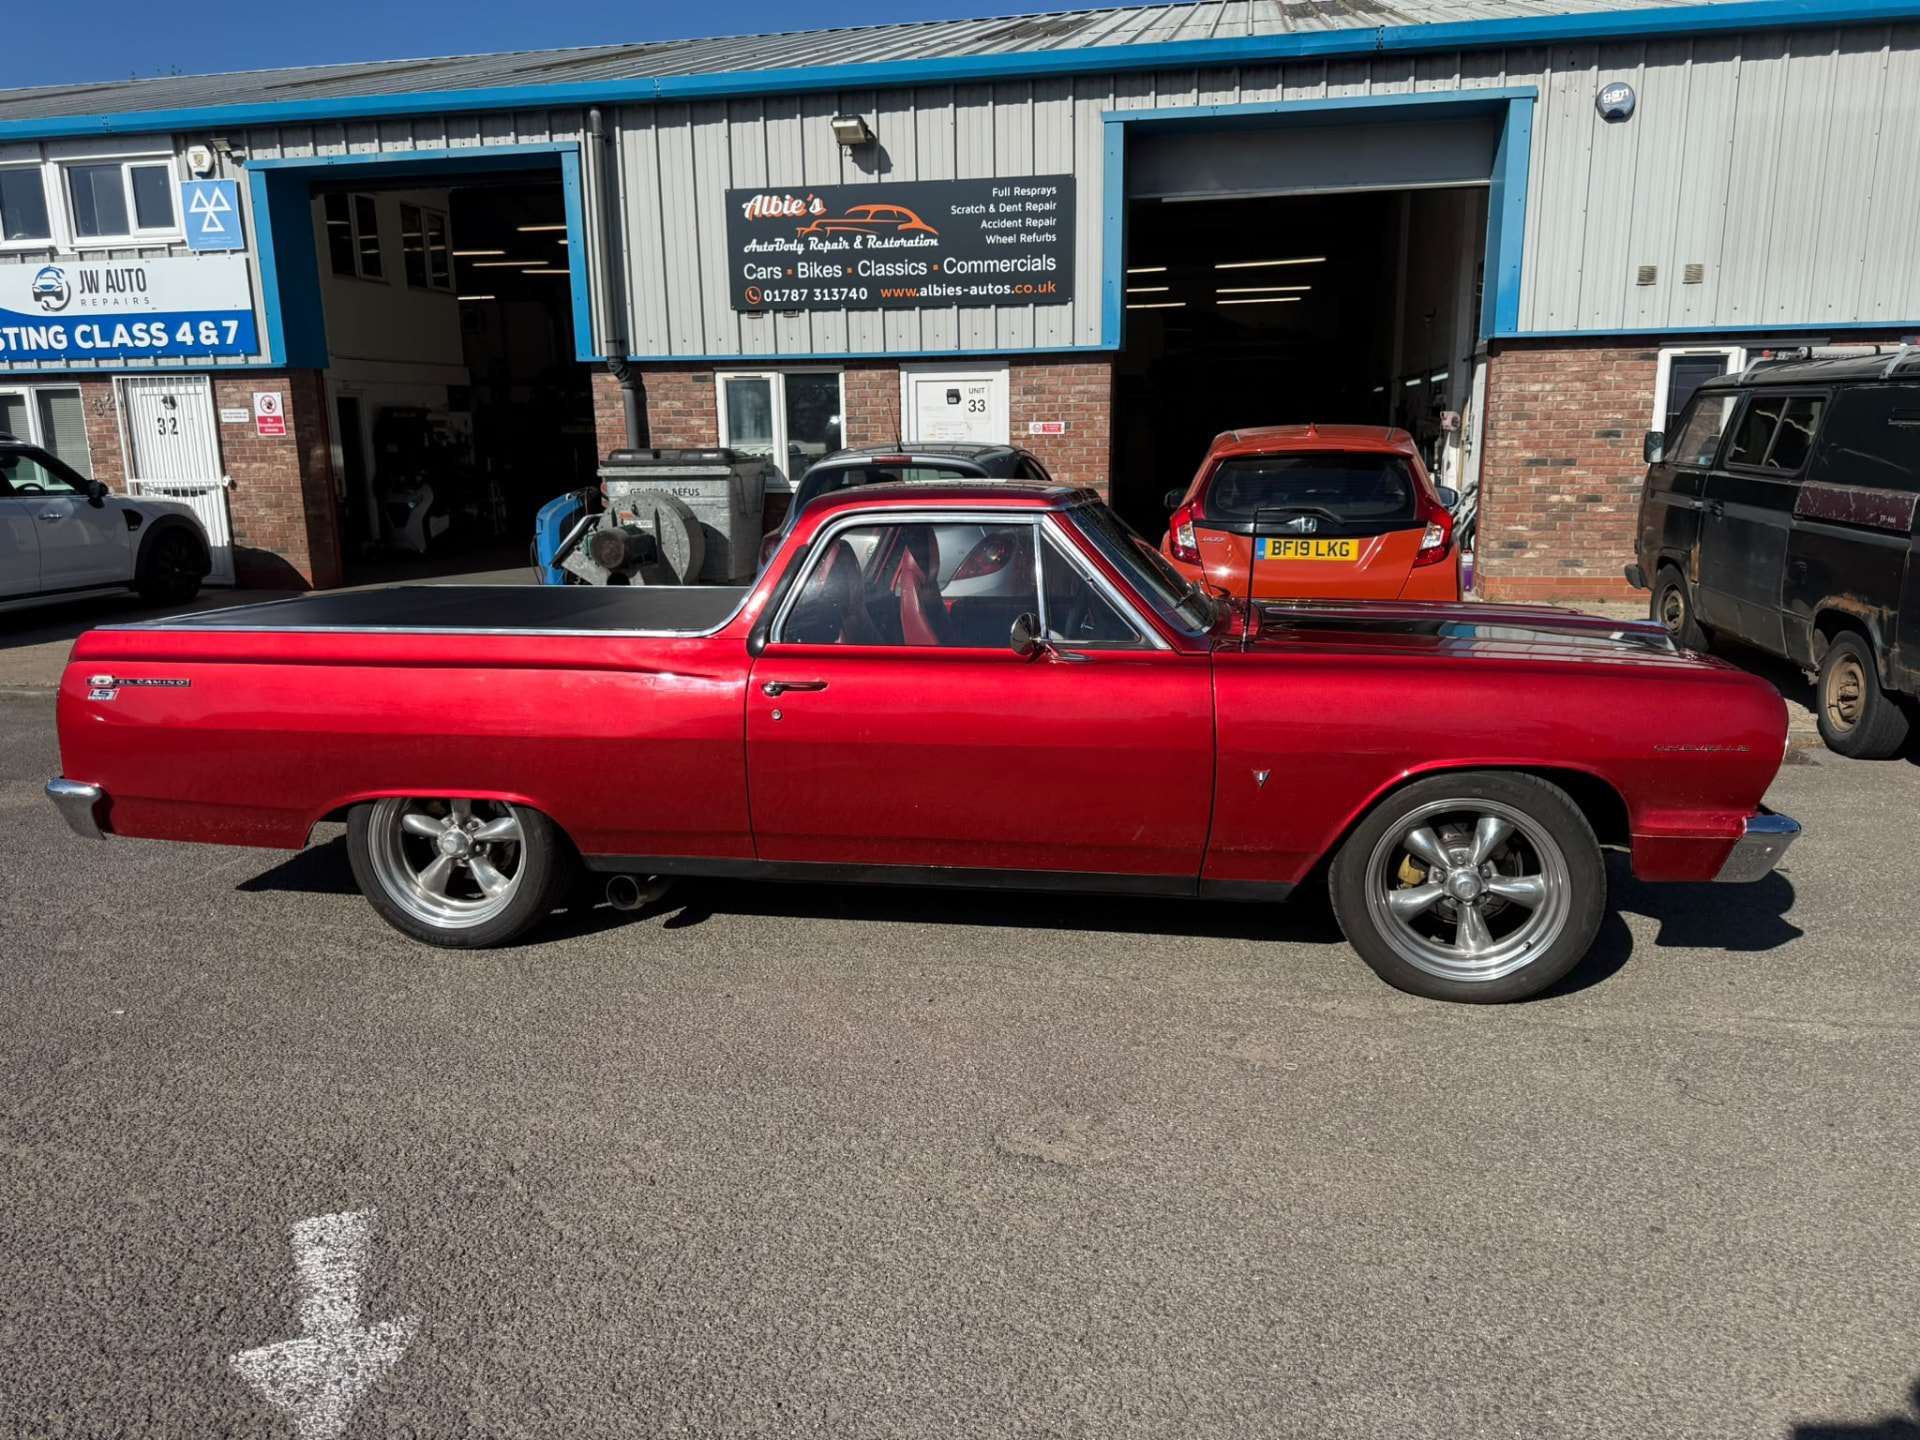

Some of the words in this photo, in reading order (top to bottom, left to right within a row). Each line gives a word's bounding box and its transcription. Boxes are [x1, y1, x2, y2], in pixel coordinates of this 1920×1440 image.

[992, 187, 1010, 197] Full
[1014, 186, 1057, 197] Resprays
[742, 193, 826, 220] Albie's
[951, 204, 985, 215] Scratch
[988, 203, 996, 213] &
[999, 202, 1022, 213] Dent
[1025, 201, 1057, 213] Repair
[980, 218, 1022, 229] Accident
[1025, 216, 1057, 228] Repair
[743, 238, 805, 255] AutoBody
[808, 236, 850, 253] Repair
[853, 235, 863, 249] &
[866, 233, 939, 249] Restoration
[985, 234, 1016, 244] Wheel
[1020, 232, 1057, 243] Refurbs
[743, 263, 782, 280] Cars
[797, 261, 842, 278] Bikes
[857, 259, 927, 277] Classics
[943, 254, 1056, 274] Commercials
[79, 269, 100, 294] JW
[106, 267, 147, 293] AUTO
[763, 289, 808, 302] 01787
[813, 287, 868, 301] 313740
[880, 281, 1056, 298] www.albies-autos.co.uk
[81, 297, 150, 307] REPAIRS
[0, 325, 67, 350] TING
[74, 321, 169, 349] CLASS
[175, 321, 194, 346] 4
[199, 320, 219, 345] &
[222, 319, 239, 345] 7
[968, 399, 986, 413] 33
[157, 417, 178, 436] 32
[1271, 540, 1310, 556] BF19
[1315, 541, 1350, 557] LKG
